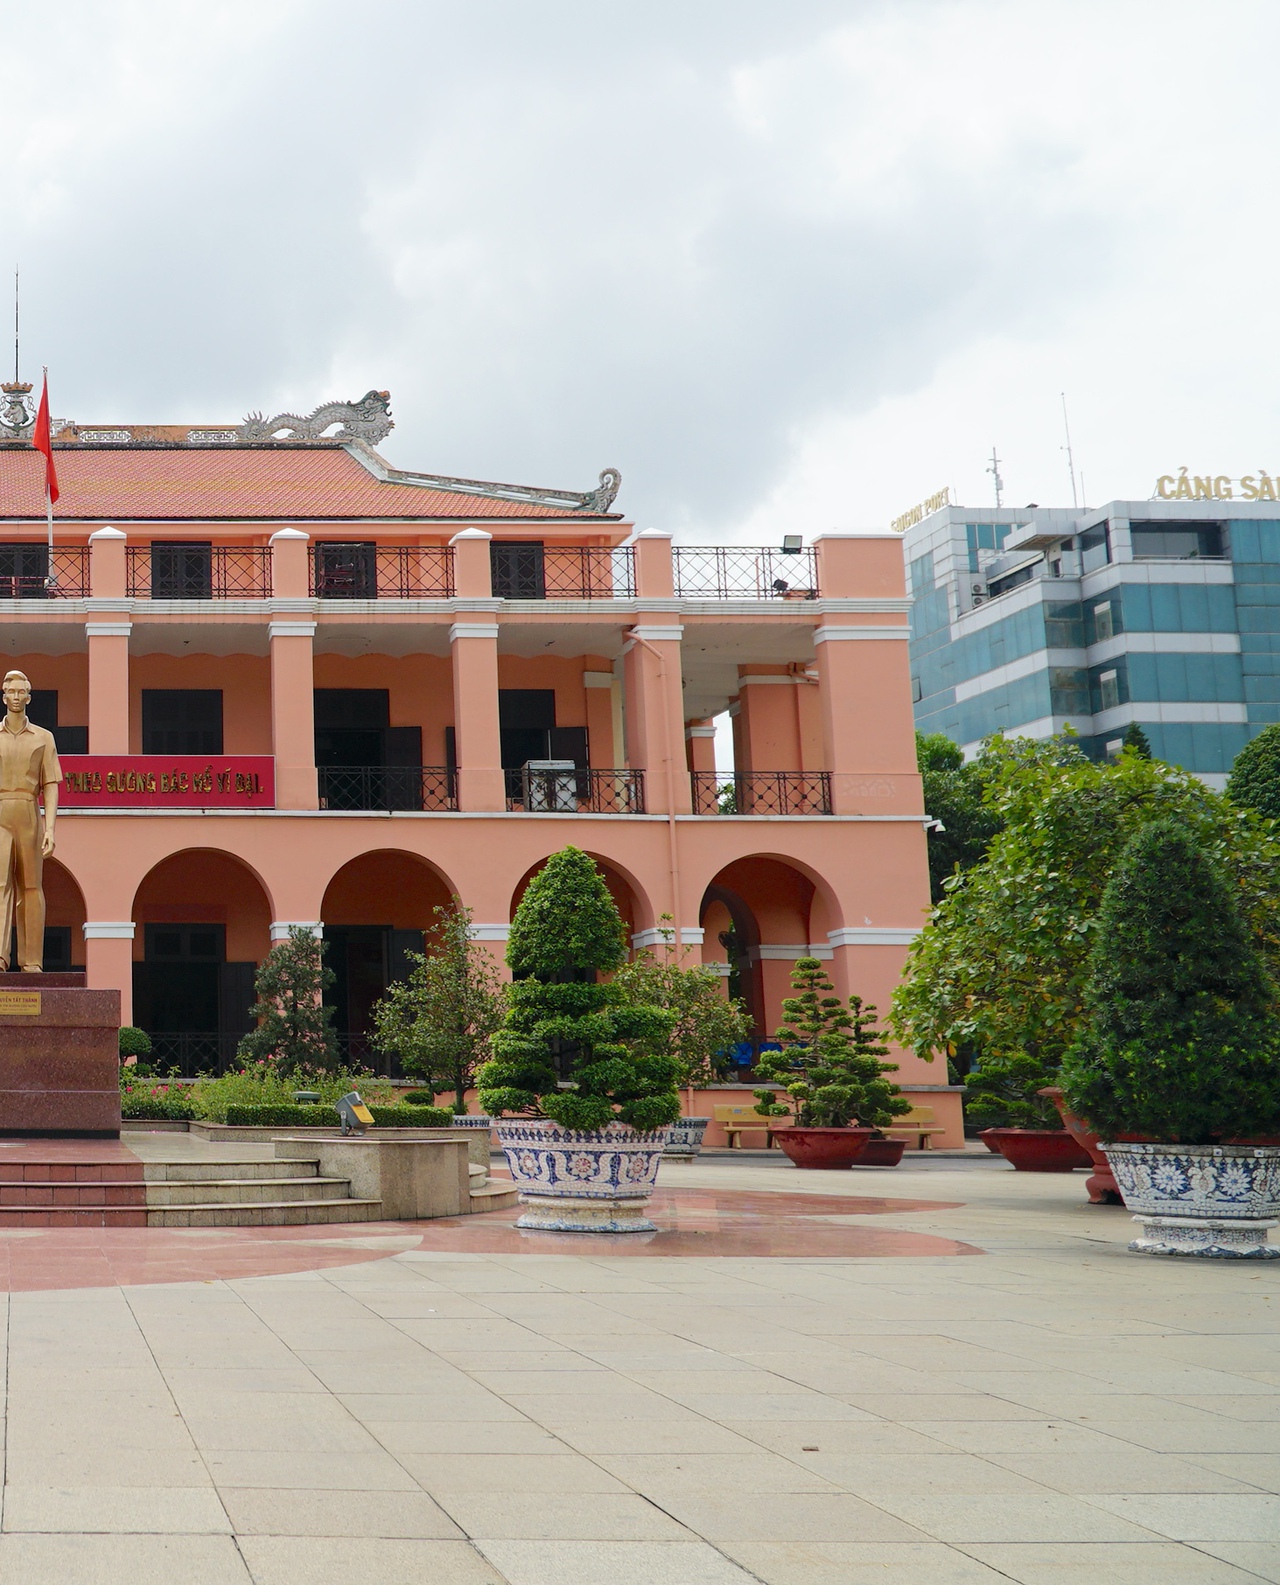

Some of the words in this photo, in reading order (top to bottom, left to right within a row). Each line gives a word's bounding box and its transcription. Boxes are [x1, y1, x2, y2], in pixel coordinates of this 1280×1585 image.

[1158, 466, 1233, 500] CẢNG
[890, 503, 923, 532] SAIGON
[924, 486, 949, 516] PORT
[65, 771, 102, 794] THEO
[106, 768, 157, 794] GƯƠNG
[160, 767, 189, 794] BÁC
[192, 764, 214, 794] HỒ
